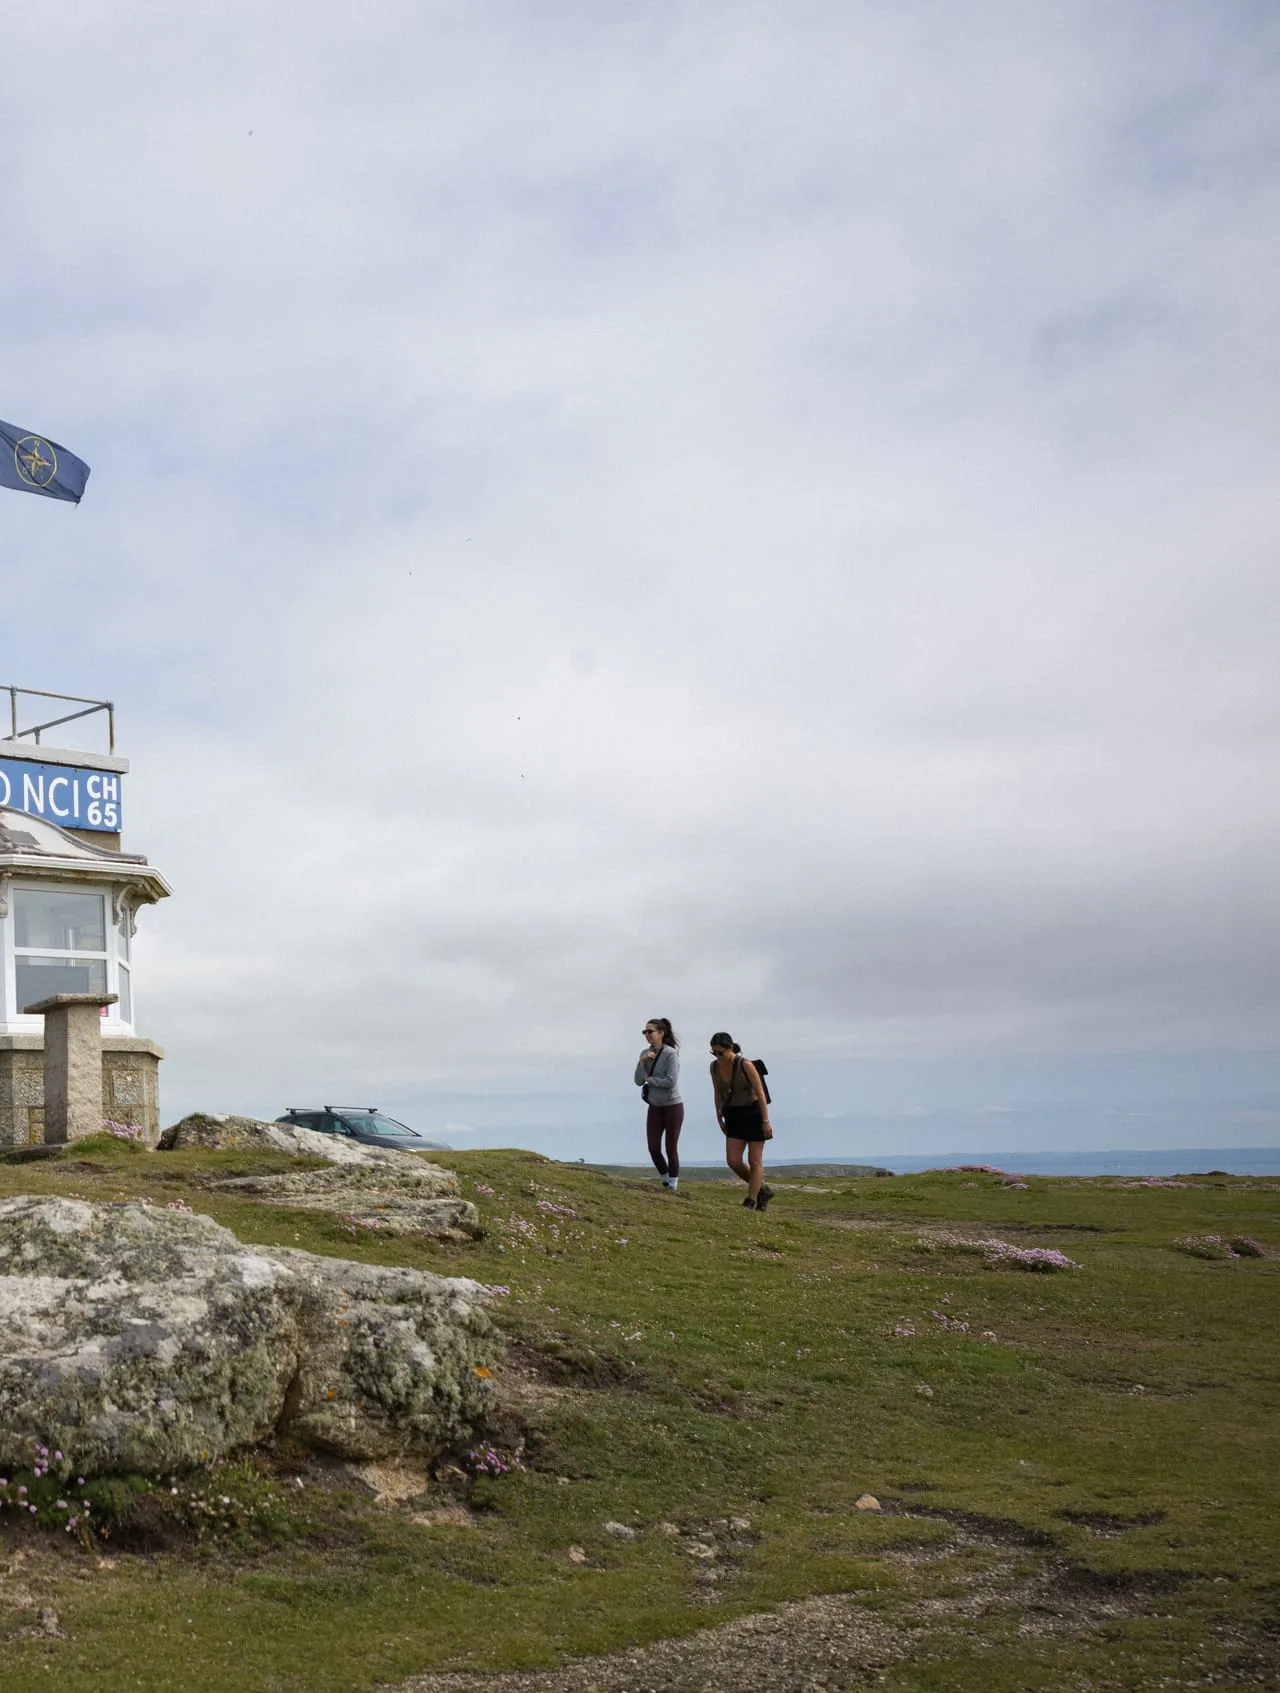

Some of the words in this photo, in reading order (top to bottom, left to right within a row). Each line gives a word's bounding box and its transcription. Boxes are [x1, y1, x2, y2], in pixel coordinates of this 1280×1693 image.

[23, 773, 80, 818] NCI
[86, 775, 117, 801] CH
[87, 801, 118, 827] 65
